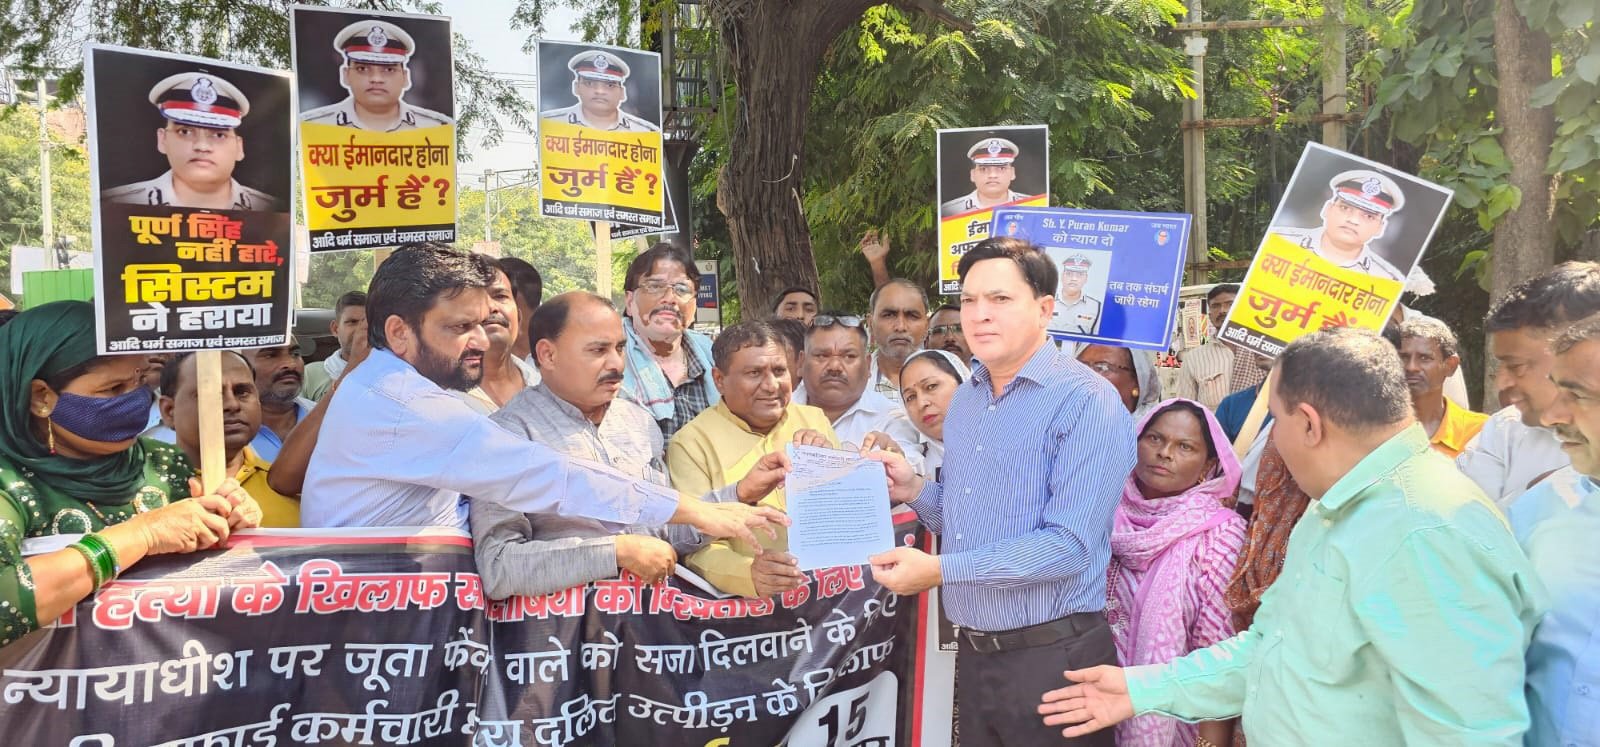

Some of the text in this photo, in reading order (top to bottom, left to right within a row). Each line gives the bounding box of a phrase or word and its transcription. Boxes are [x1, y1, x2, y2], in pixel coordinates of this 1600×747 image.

[308, 136, 450, 170] क्या ईमानदार होना
[545, 131, 657, 163] क्या ईमानदार होना
[546, 163, 608, 197] जुर्म
[312, 175, 388, 222] जुर्म
[545, 202, 563, 215] आदि
[564, 204, 578, 216] धर्म
[578, 207, 602, 219] समाज
[129, 212, 244, 245] पूर्ण सिंह
[312, 229, 454, 248] आदि धर्म समाज एवं समस्त समाज
[1042, 217, 1056, 229] Sh.
[1068, 219, 1095, 231] Puran
[1098, 221, 1130, 233] Kumar
[1053, 230, 1115, 247] को न्याय दो
[175, 239, 284, 267] नहीं हारे,
[121, 263, 276, 304] सिस्टम
[1109, 280, 1169, 295] तब तक संघर्ष
[1261, 253, 1389, 317] क्या ईमानदार होना
[1114, 293, 1160, 308] जारी रहेगा
[1248, 287, 1321, 330] जुर्म
[130, 302, 273, 333] ने हराया
[109, 334, 285, 351] आदि धर्म समाज एवं समस्त समाज
[1225, 326, 1248, 342] आदि
[1246, 335, 1265, 348] धर्म
[92, 577, 224, 630] हत्या
[231, 561, 290, 616] के
[295, 559, 451, 615] खिलाफ
[3, 639, 253, 710] न्यायाधीश
[268, 643, 332, 680] पर
[344, 643, 433, 693] जूता
[505, 636, 571, 685] वाले
[581, 631, 623, 671] को
[635, 644, 696, 675] सजा
[698, 617, 813, 672] दिलवाने
[823, 608, 857, 646] के
[291, 689, 460, 745] कर्मचारी
[533, 693, 622, 747] दलित
[628, 691, 757, 733] उत्पीड़न
[762, 678, 799, 717] के
[818, 691, 870, 747] 15
